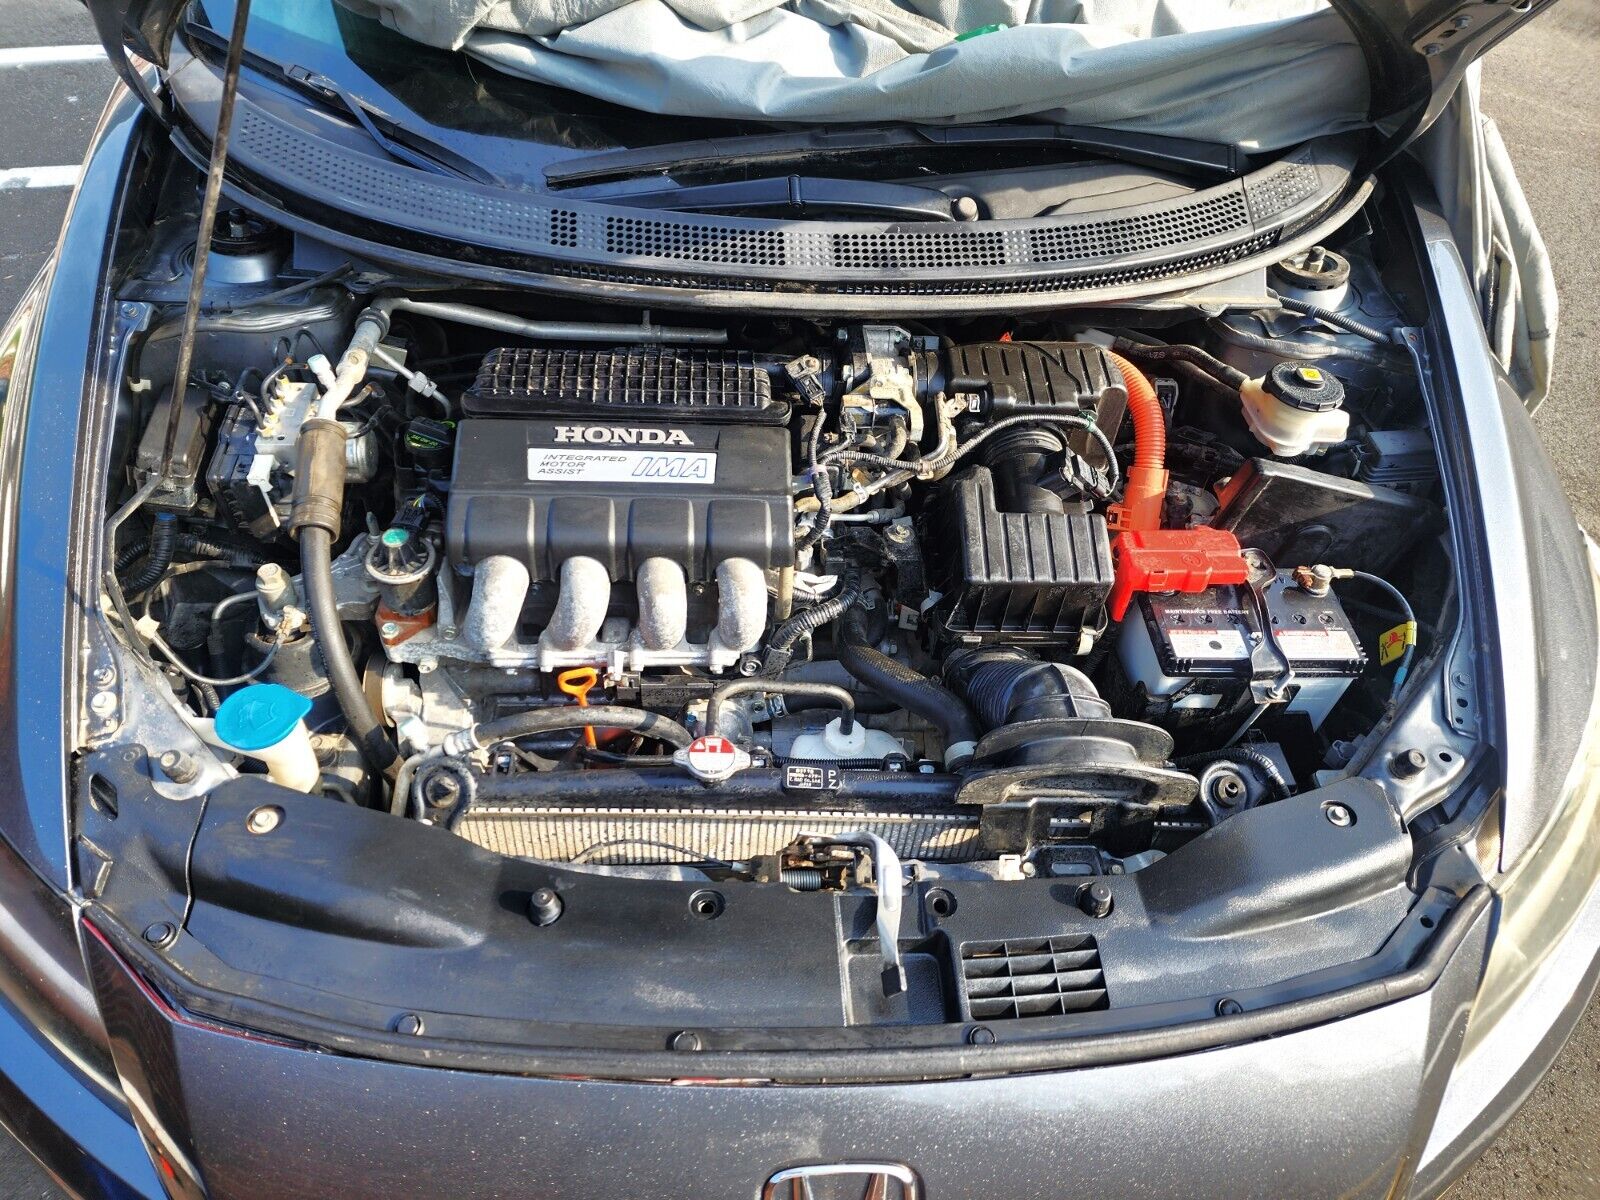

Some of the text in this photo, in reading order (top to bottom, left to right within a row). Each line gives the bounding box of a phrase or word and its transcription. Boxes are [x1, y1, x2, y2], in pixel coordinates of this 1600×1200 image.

[554, 426, 694, 445] HONDA
[543, 454, 627, 462] INTEGRATED
[632, 457, 708, 478] IMA
[828, 770, 836, 778] P
